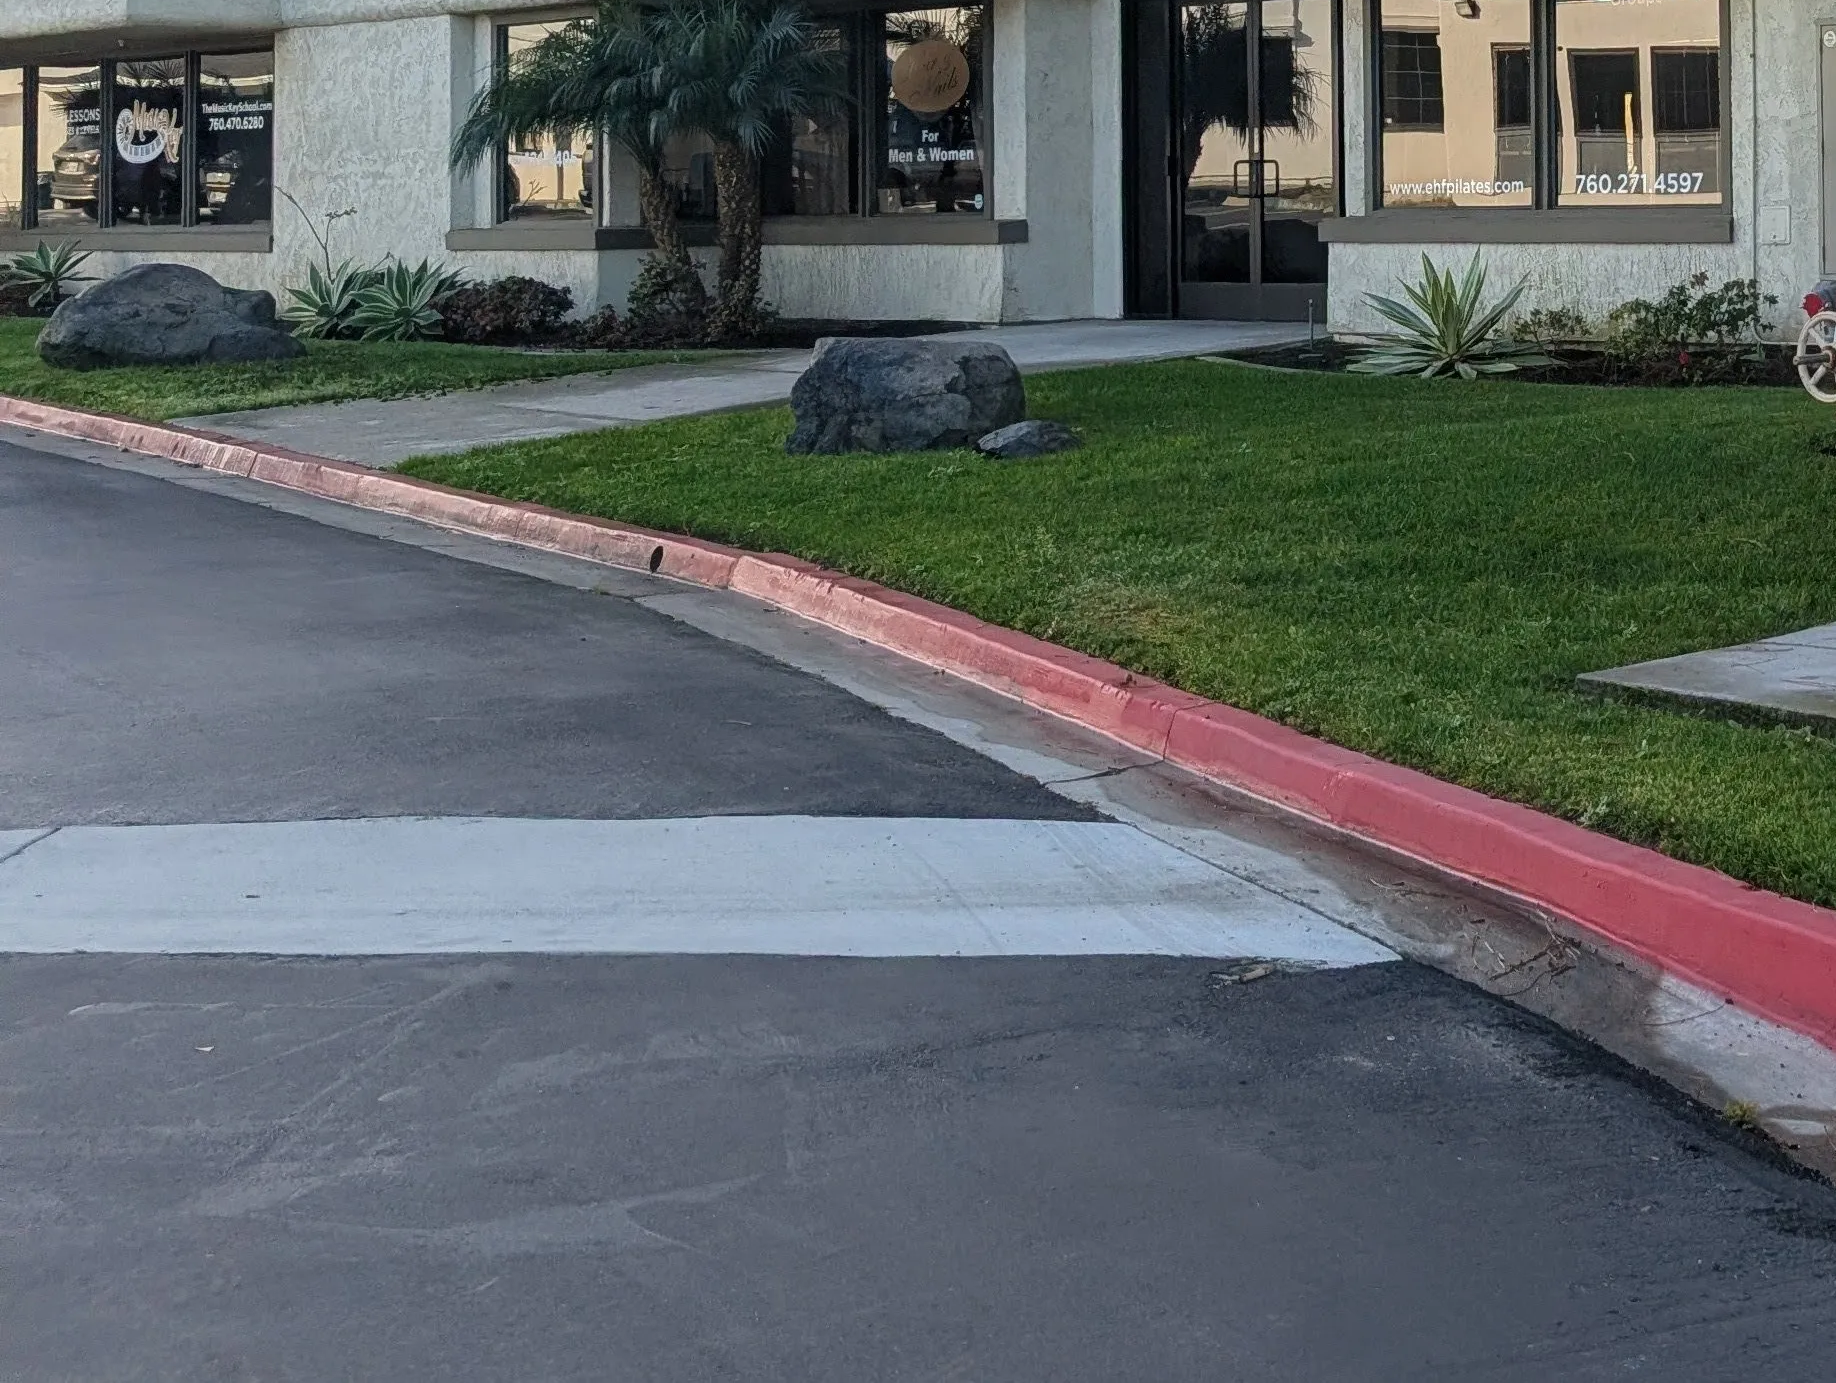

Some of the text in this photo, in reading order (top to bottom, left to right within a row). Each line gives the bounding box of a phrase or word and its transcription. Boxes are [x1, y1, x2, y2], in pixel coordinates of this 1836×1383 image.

[66, 108, 100, 123] ESSONS
[921, 129, 940, 143] For
[888, 147, 975, 163] Men & Women
[1389, 178, 1524, 196] www.ehfpilates.com
[1575, 172, 1704, 194] 760.271.4597
